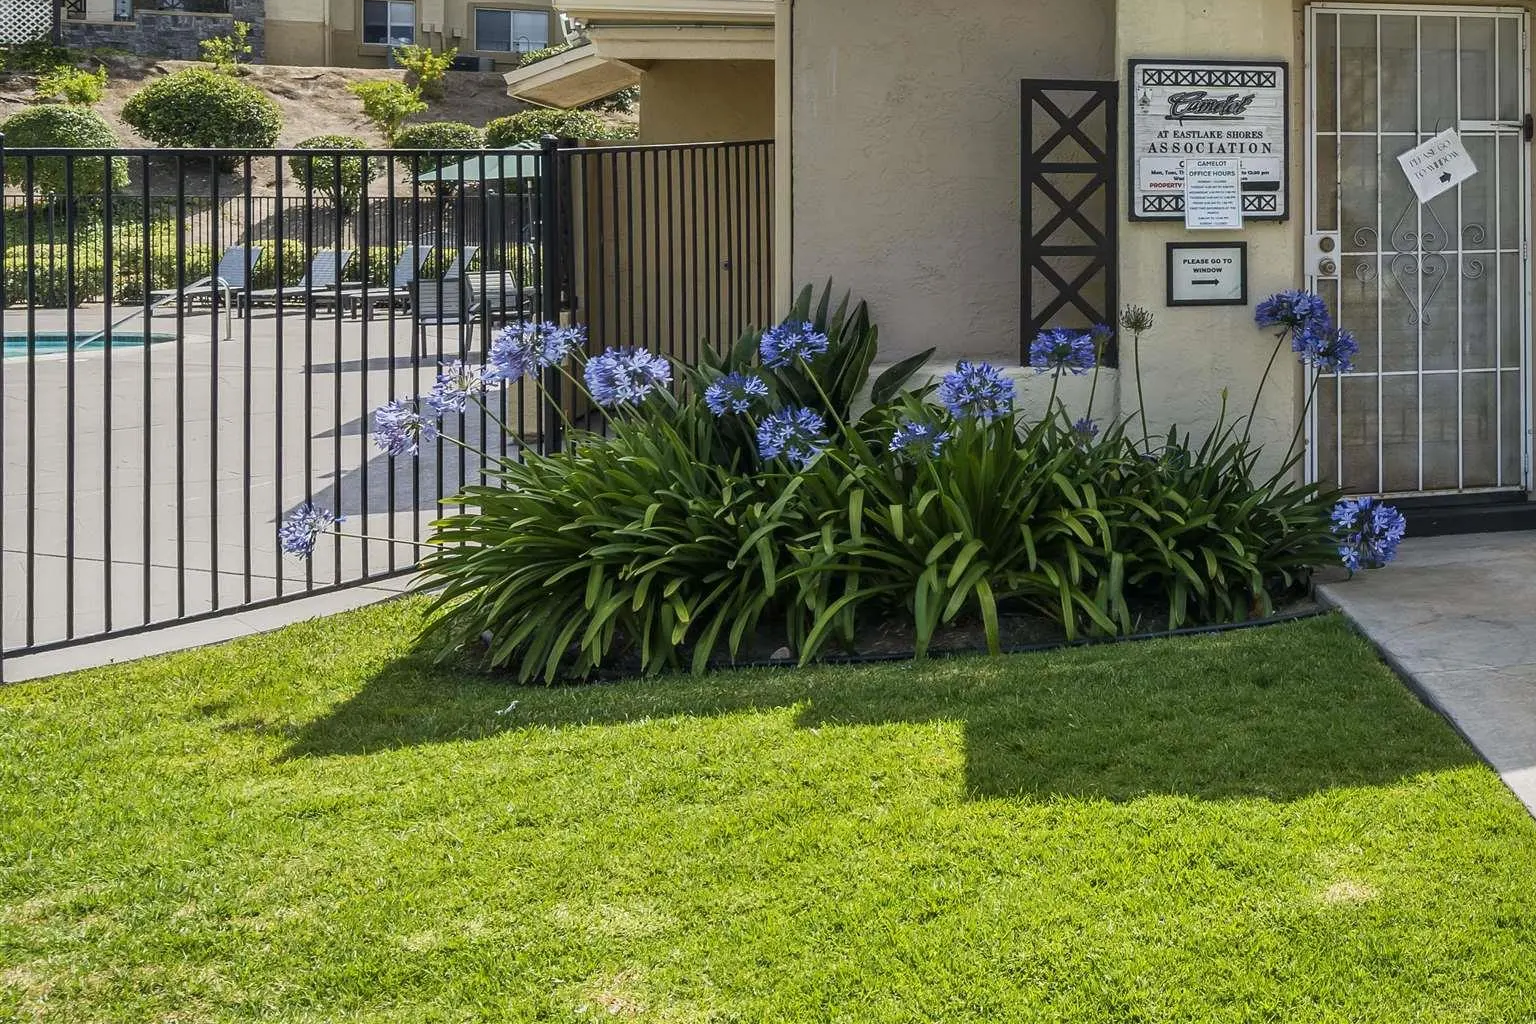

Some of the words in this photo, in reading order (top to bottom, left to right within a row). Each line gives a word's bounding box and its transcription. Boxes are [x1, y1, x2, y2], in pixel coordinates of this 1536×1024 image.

[1167, 90, 1256, 116] Camelot
[1157, 131, 1169, 139] AT
[1173, 130, 1223, 139] EASTLAKE
[1226, 131, 1264, 139] SHORES
[1147, 142, 1272, 154] ASSOCIATION
